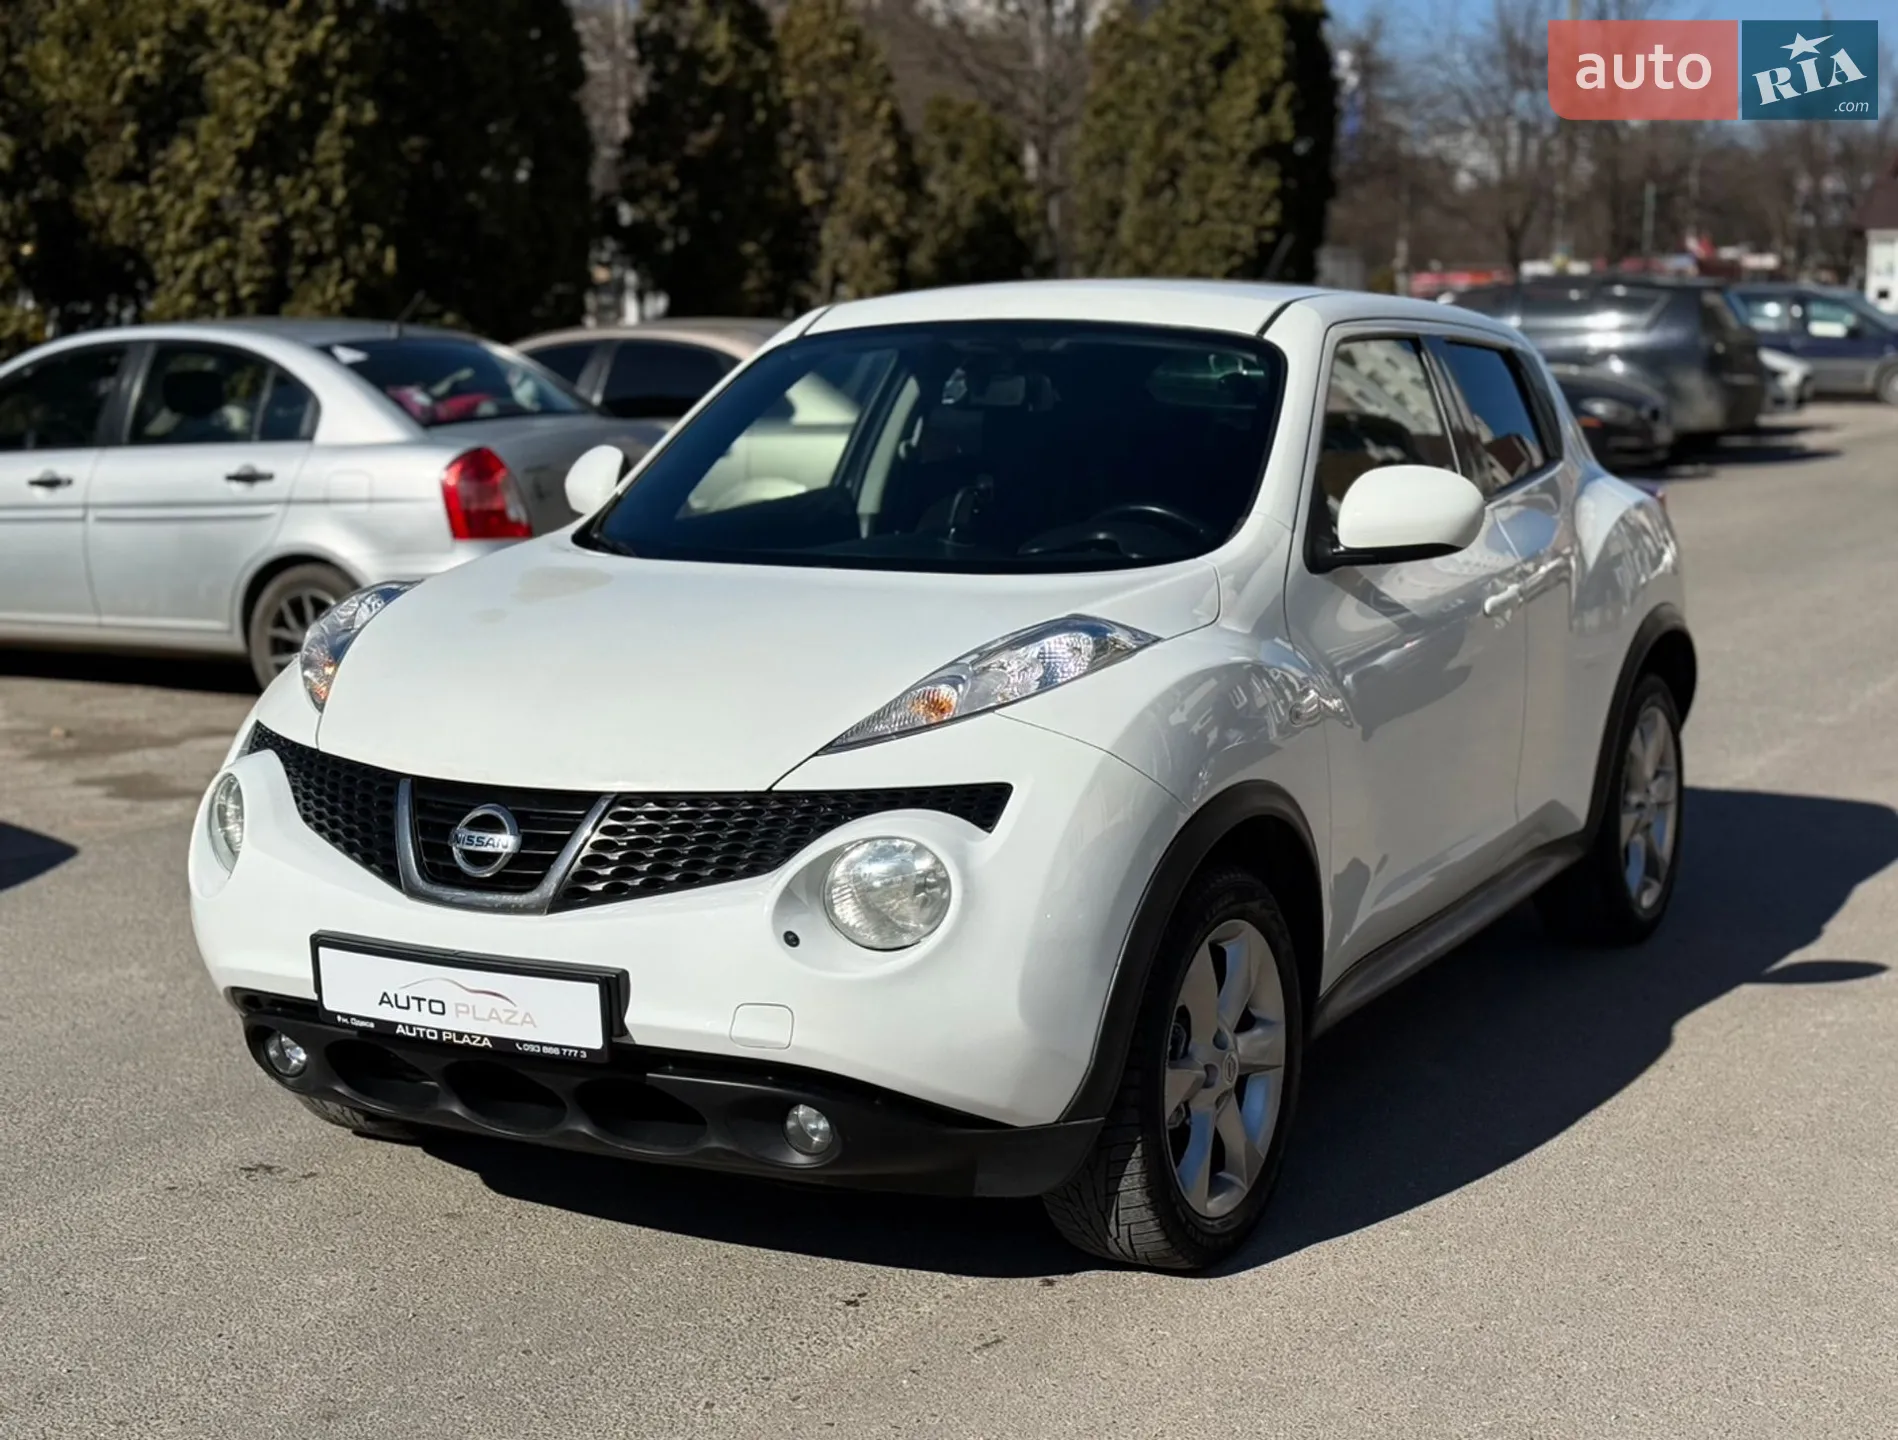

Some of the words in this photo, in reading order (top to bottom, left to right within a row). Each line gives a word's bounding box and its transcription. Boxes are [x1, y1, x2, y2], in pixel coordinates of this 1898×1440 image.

[453, 833, 508, 849] NISSAN
[378, 991, 446, 1016] AUTO
[455, 1002, 537, 1029] PLAZA
[395, 1023, 438, 1040] AUTO
[442, 1031, 493, 1048] PLAZA
[561, 1048, 579, 1057] 777
